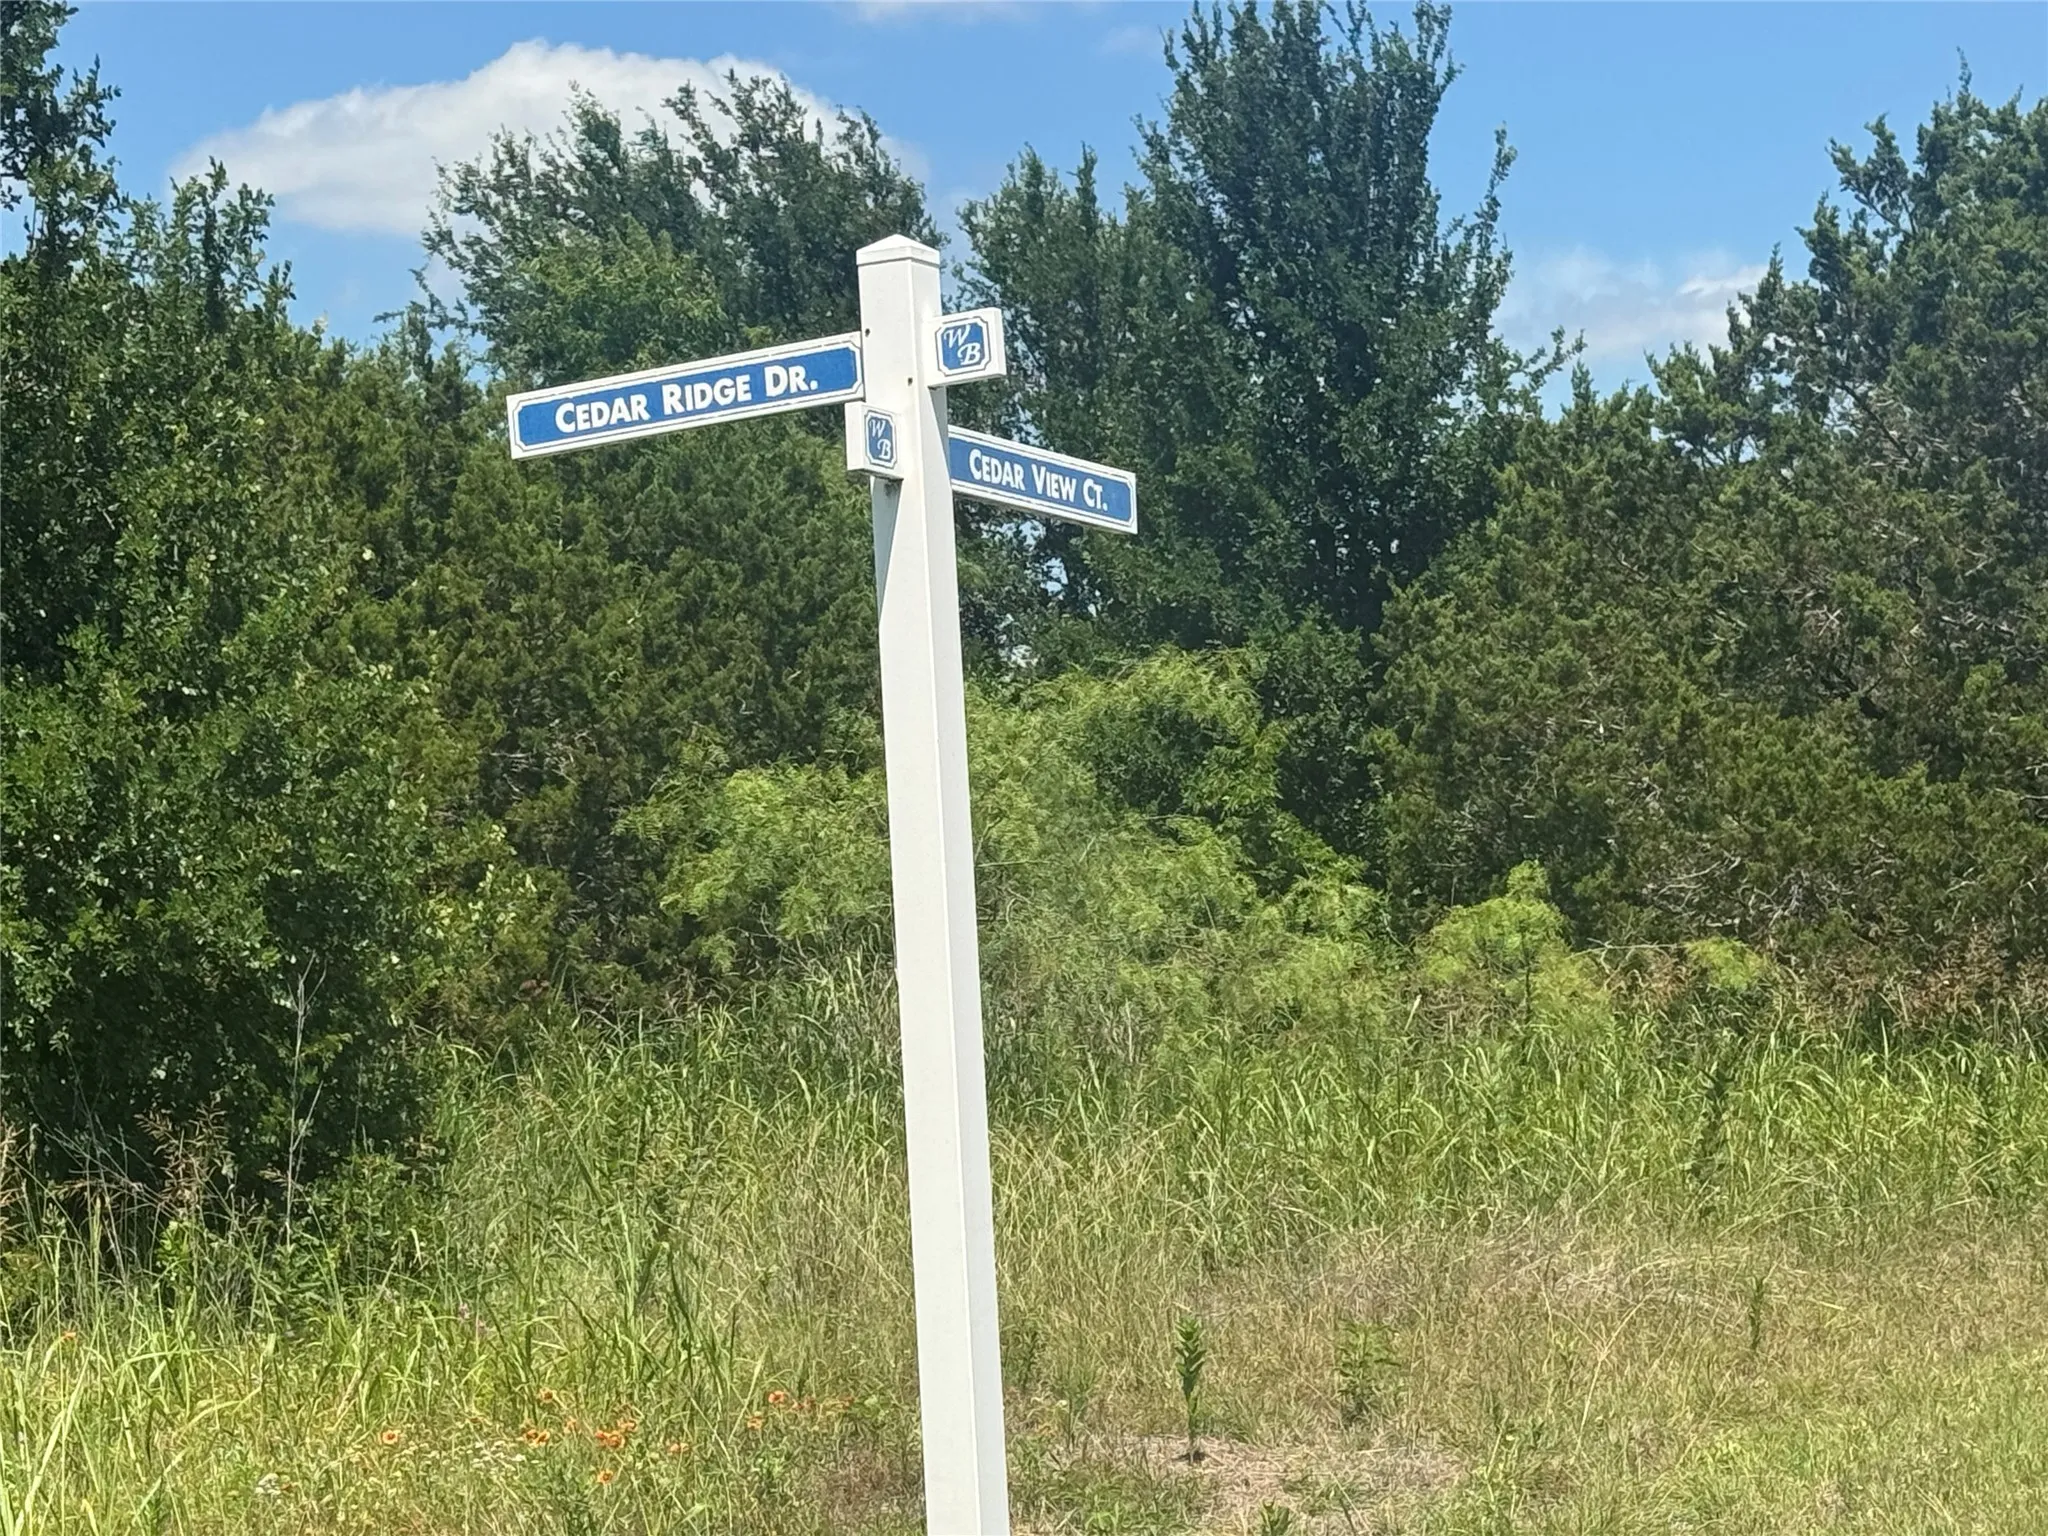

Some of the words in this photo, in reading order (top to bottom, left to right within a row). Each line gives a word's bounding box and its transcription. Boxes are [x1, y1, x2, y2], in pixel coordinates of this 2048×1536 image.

[555, 394, 651, 434] CEDAR
[662, 375, 752, 415] RIDGE
[764, 365, 818, 398] DR.
[969, 448, 1026, 491] CEDAR
[1031, 464, 1077, 503] VIEW
[1083, 478, 1108, 511] CT.
